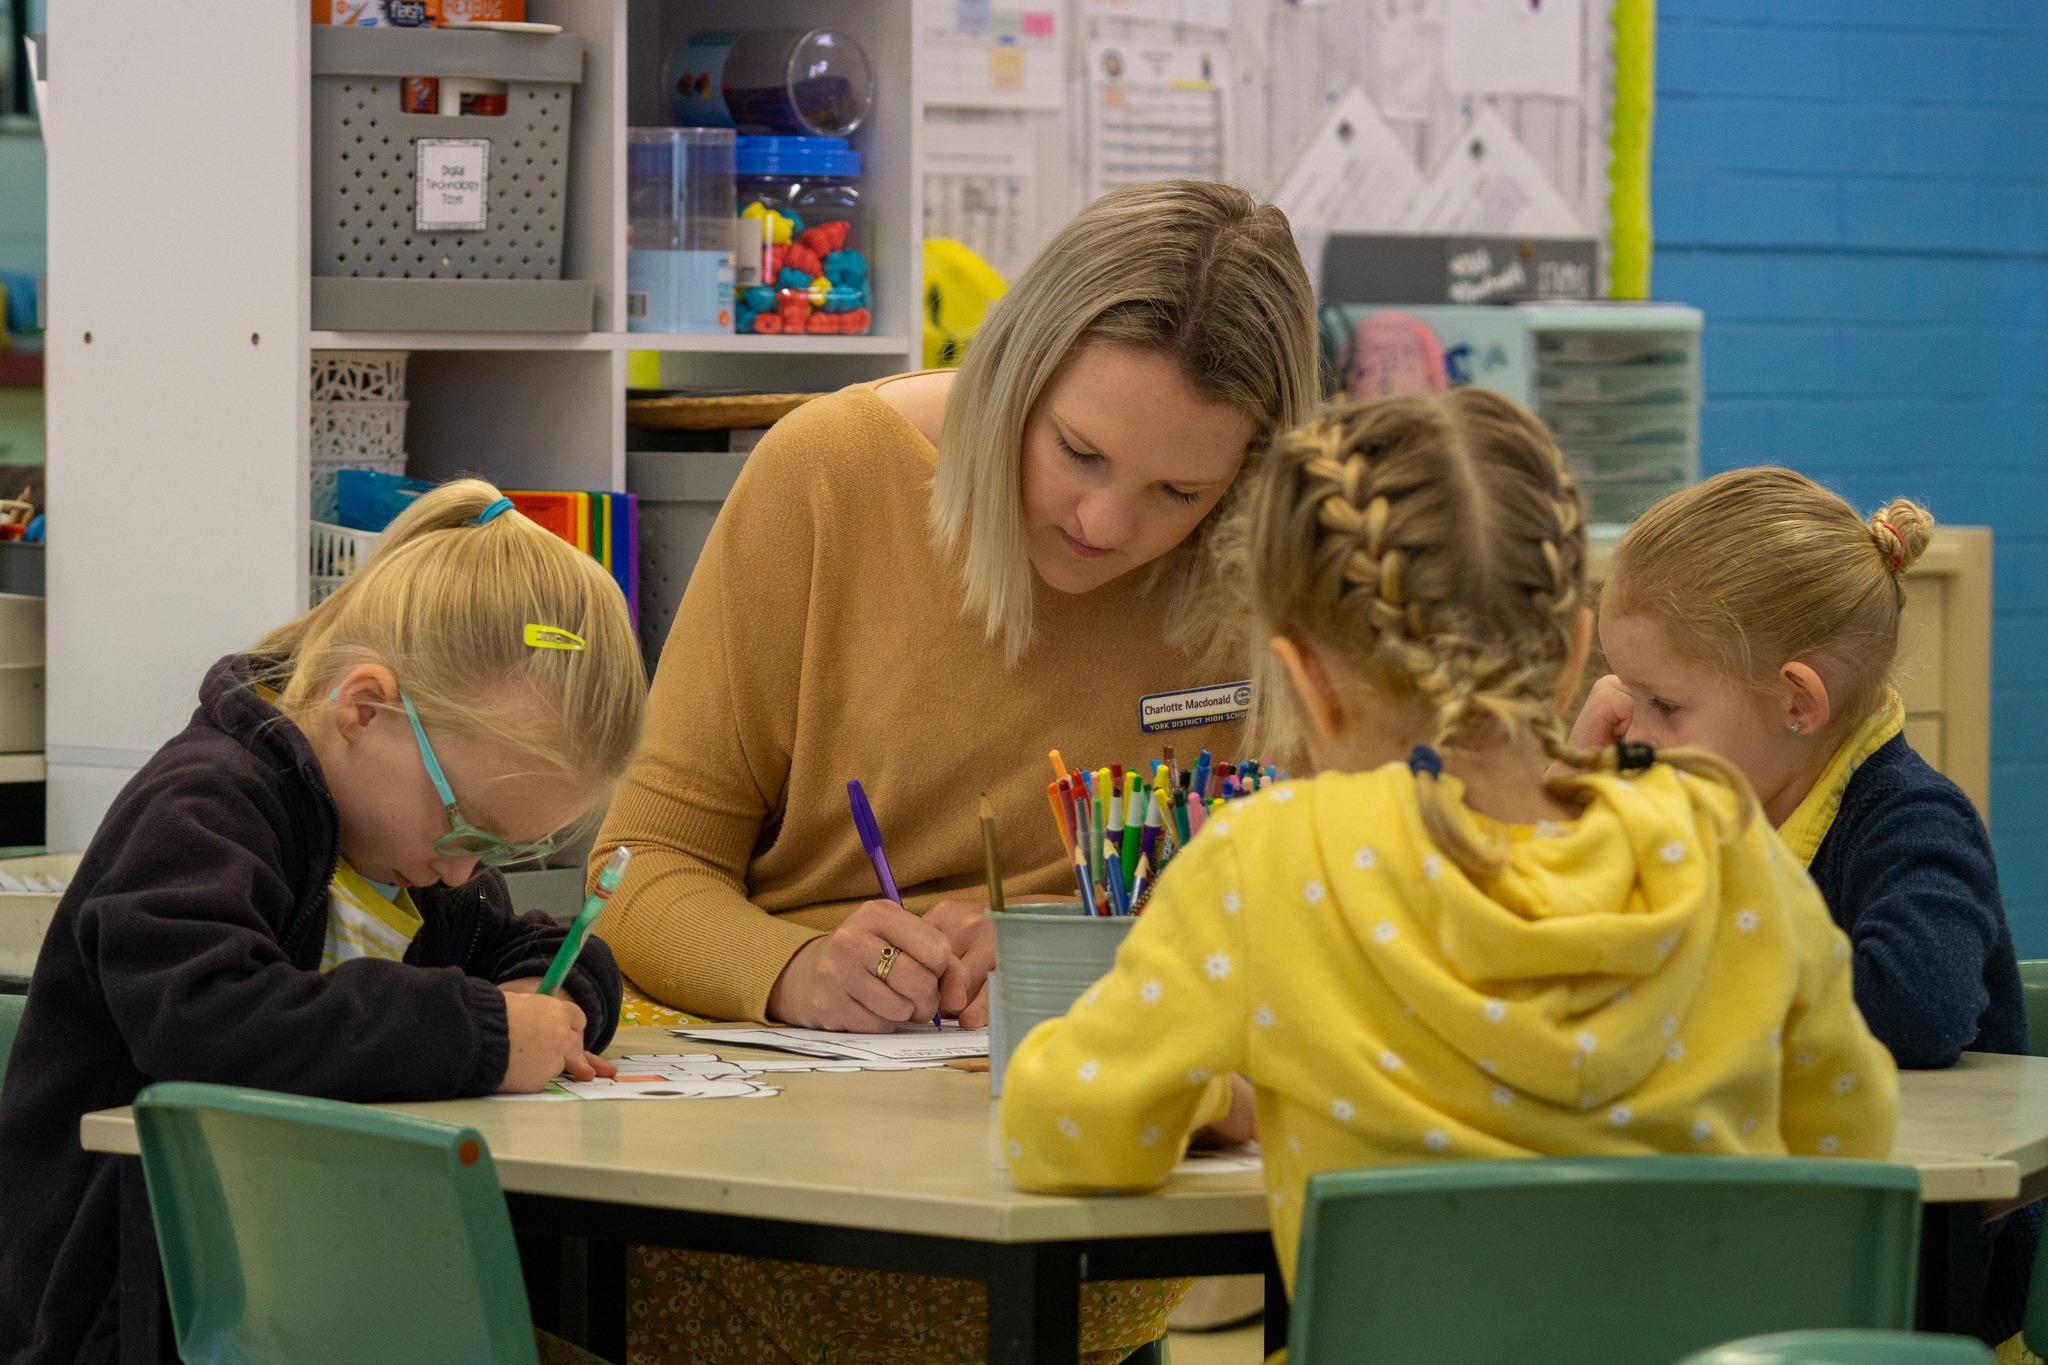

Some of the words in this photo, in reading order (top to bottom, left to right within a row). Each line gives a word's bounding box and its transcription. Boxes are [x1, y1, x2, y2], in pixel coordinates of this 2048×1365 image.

[426, 178, 479, 192] Technology
[441, 193, 464, 206] Toys
[1145, 703, 1183, 715] Charlotte
[1185, 694, 1231, 709] Macdonald
[1149, 722, 1169, 731] YORK
[1171, 717, 1203, 728] DISTRICT
[1205, 714, 1224, 723] HIGH
